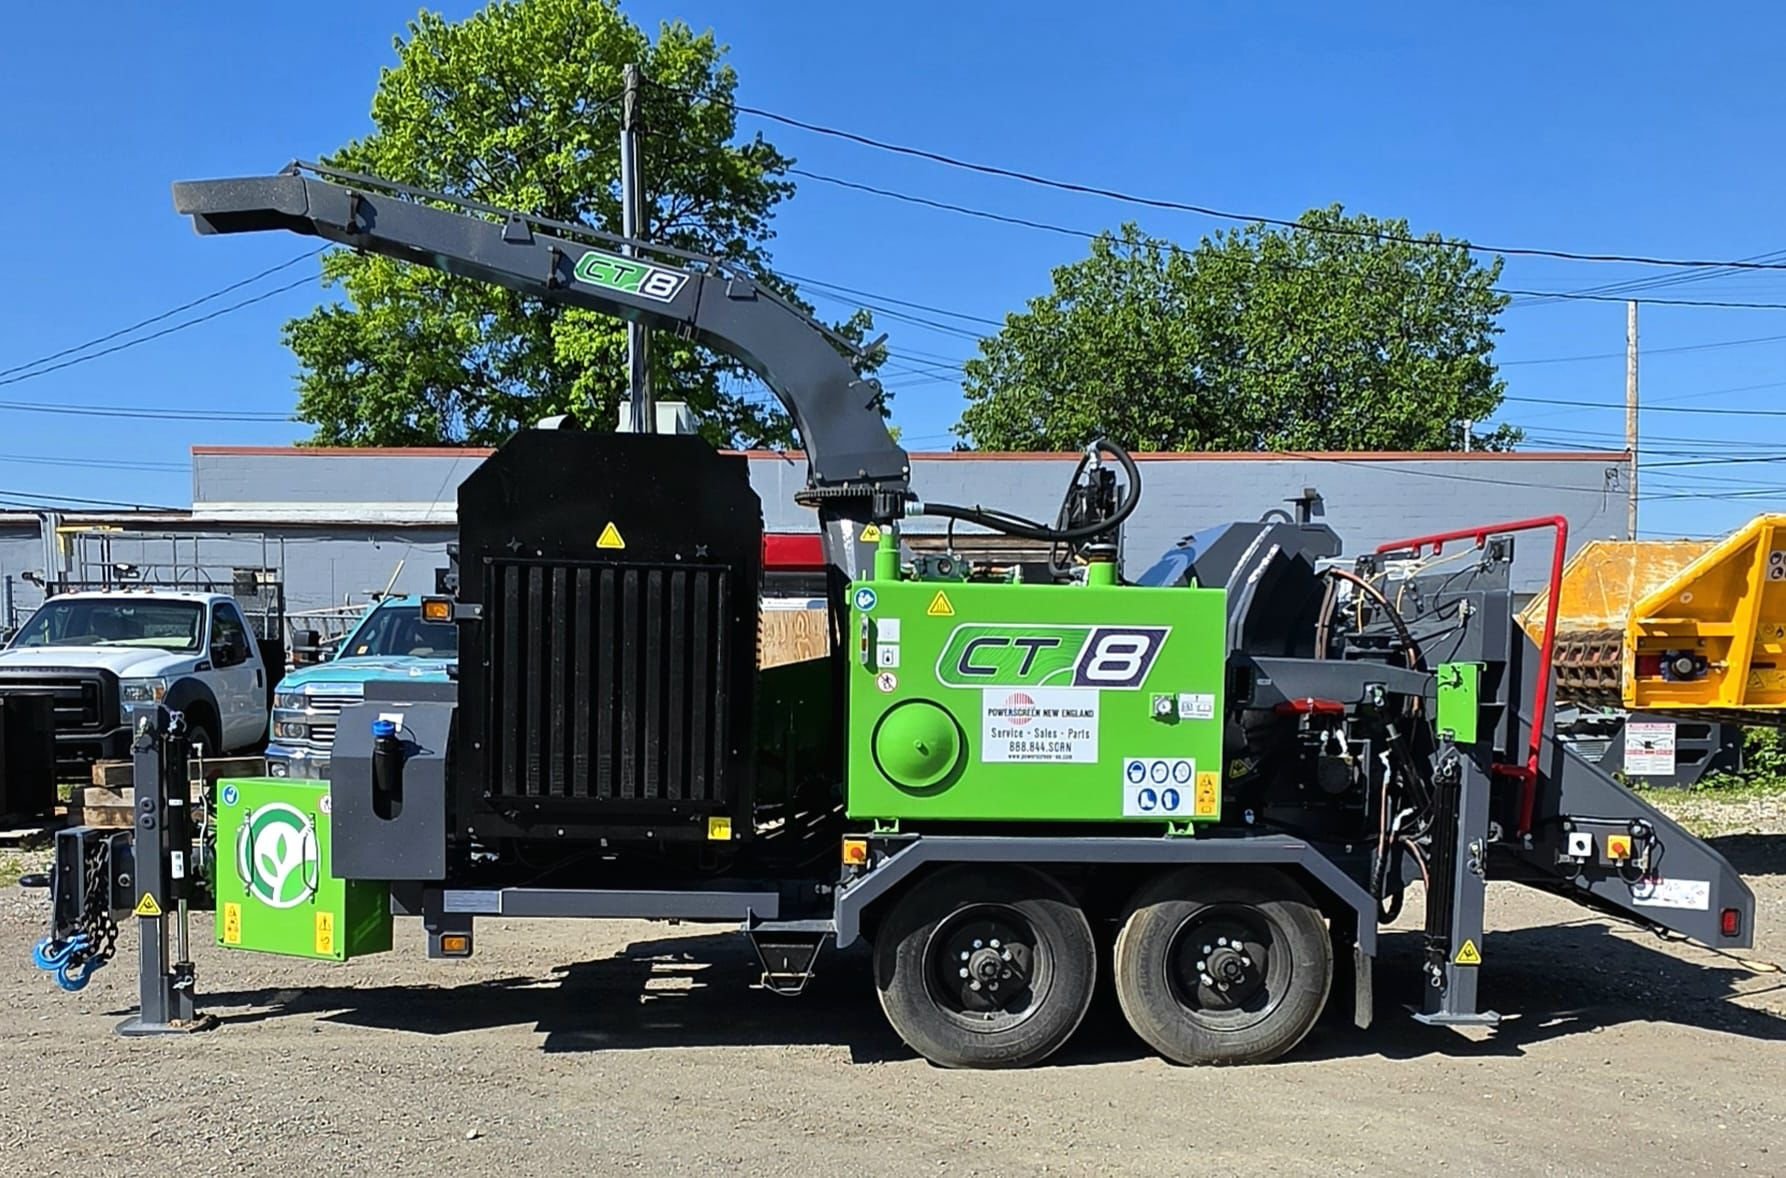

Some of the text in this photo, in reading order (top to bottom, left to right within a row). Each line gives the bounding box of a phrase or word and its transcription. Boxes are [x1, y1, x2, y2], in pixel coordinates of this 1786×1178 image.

[957, 634, 1150, 681] CT 8
[988, 707, 1095, 718] POWERSCREEN NEW ENGLAND
[991, 727, 1024, 738] Service
[1034, 727, 1058, 738] Sales
[1068, 728, 1090, 739] Parts
